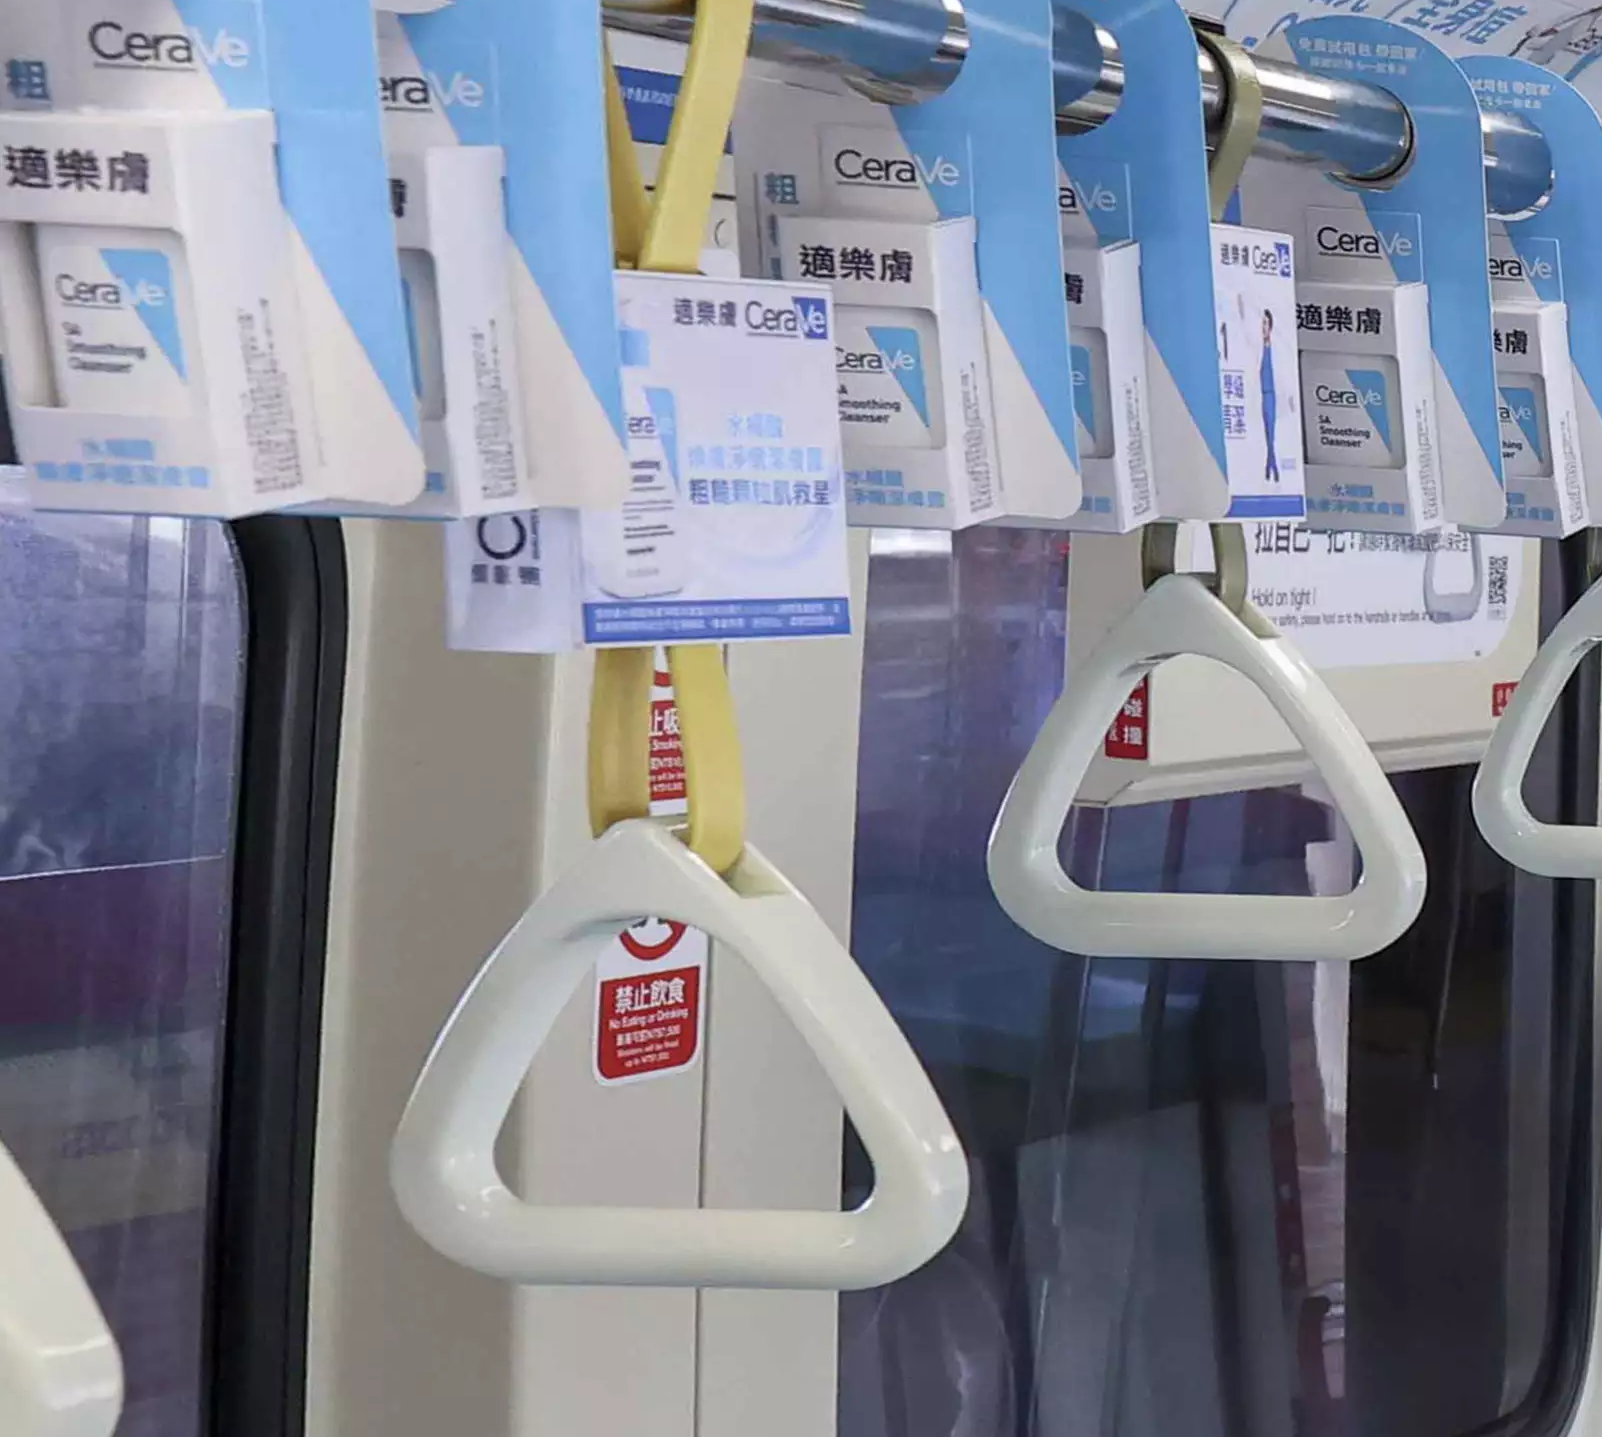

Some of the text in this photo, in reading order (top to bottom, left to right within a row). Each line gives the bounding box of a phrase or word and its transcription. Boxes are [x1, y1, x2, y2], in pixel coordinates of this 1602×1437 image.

[88, 20, 250, 67] CeraVe
[2, 144, 150, 195] 適樂膚
[834, 148, 960, 186] CeraVe
[1316, 226, 1414, 259] CeraVe
[799, 243, 914, 284] 適樂膚
[744, 297, 829, 339] CeraVe
[1296, 302, 1382, 335] 適樂膚
[1316, 383, 1383, 407] CeraVe
[1319, 424, 1371, 440] Smoothing
[1251, 589, 1274, 606] Hold
[1275, 591, 1288, 606] on
[615, 977, 685, 1014] 禁止飲食
[656, 1008, 689, 1022] Drinking
